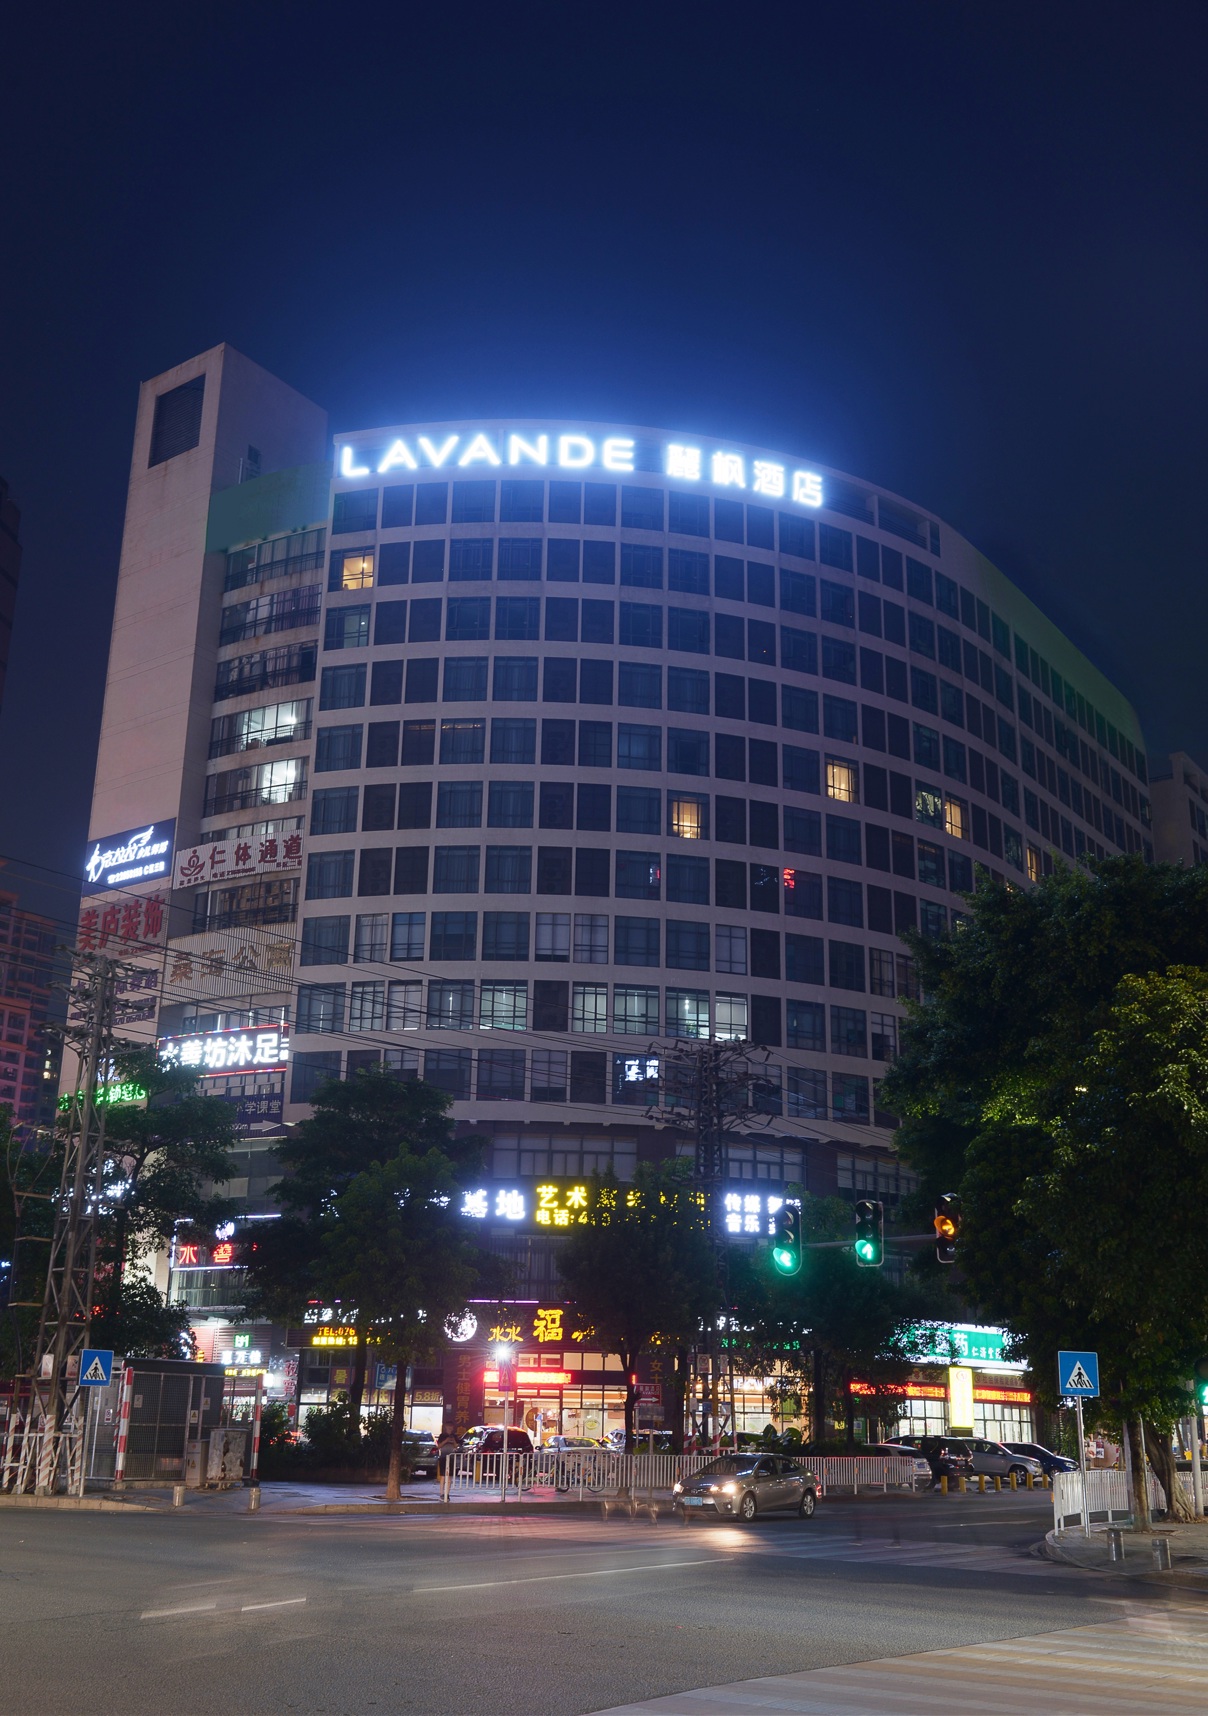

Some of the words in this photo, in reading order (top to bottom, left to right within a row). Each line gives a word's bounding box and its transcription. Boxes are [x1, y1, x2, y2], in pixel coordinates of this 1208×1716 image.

[341, 434, 635, 478] LAVANDE
[209, 834, 303, 869] 仁体通道
